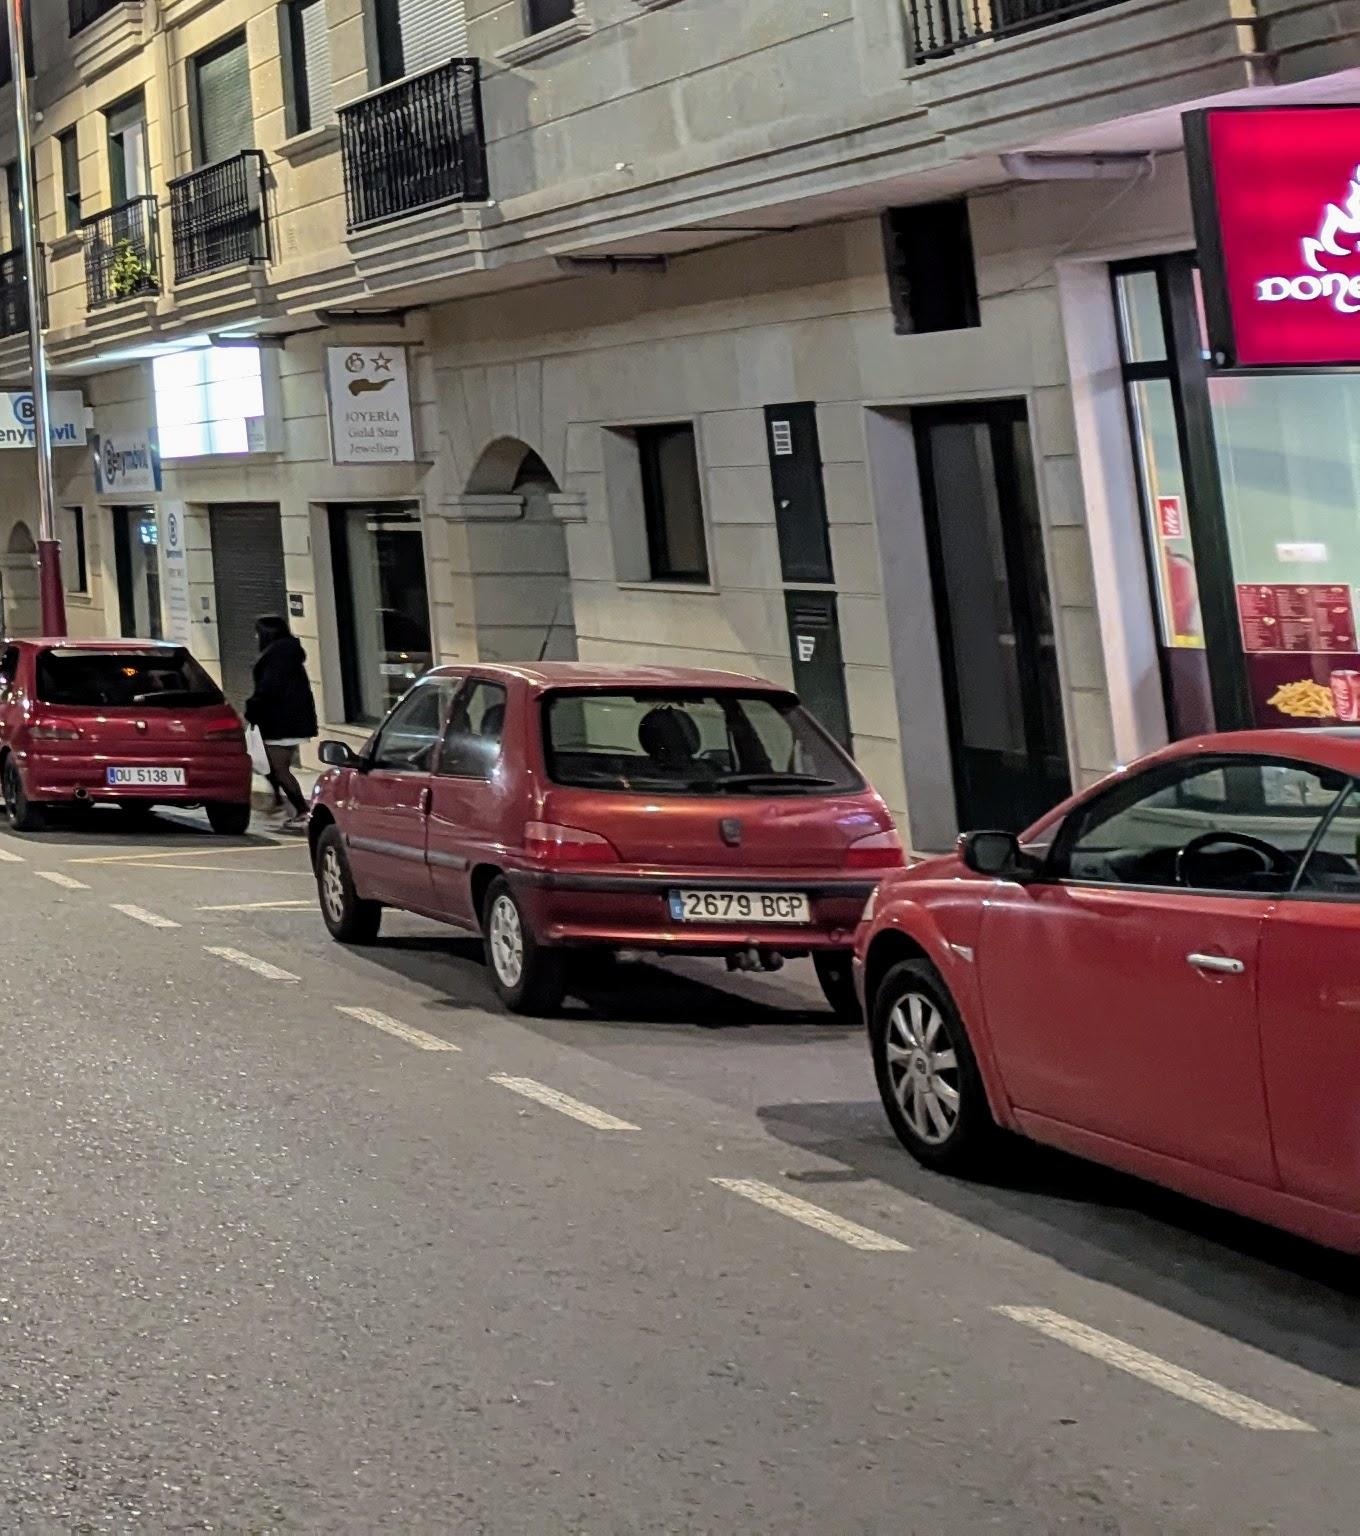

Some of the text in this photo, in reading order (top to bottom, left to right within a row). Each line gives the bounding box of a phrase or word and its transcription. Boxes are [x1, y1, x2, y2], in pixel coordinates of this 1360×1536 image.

[116, 769, 181, 783] OU 5138 V
[686, 893, 803, 918] 2679 BCP
